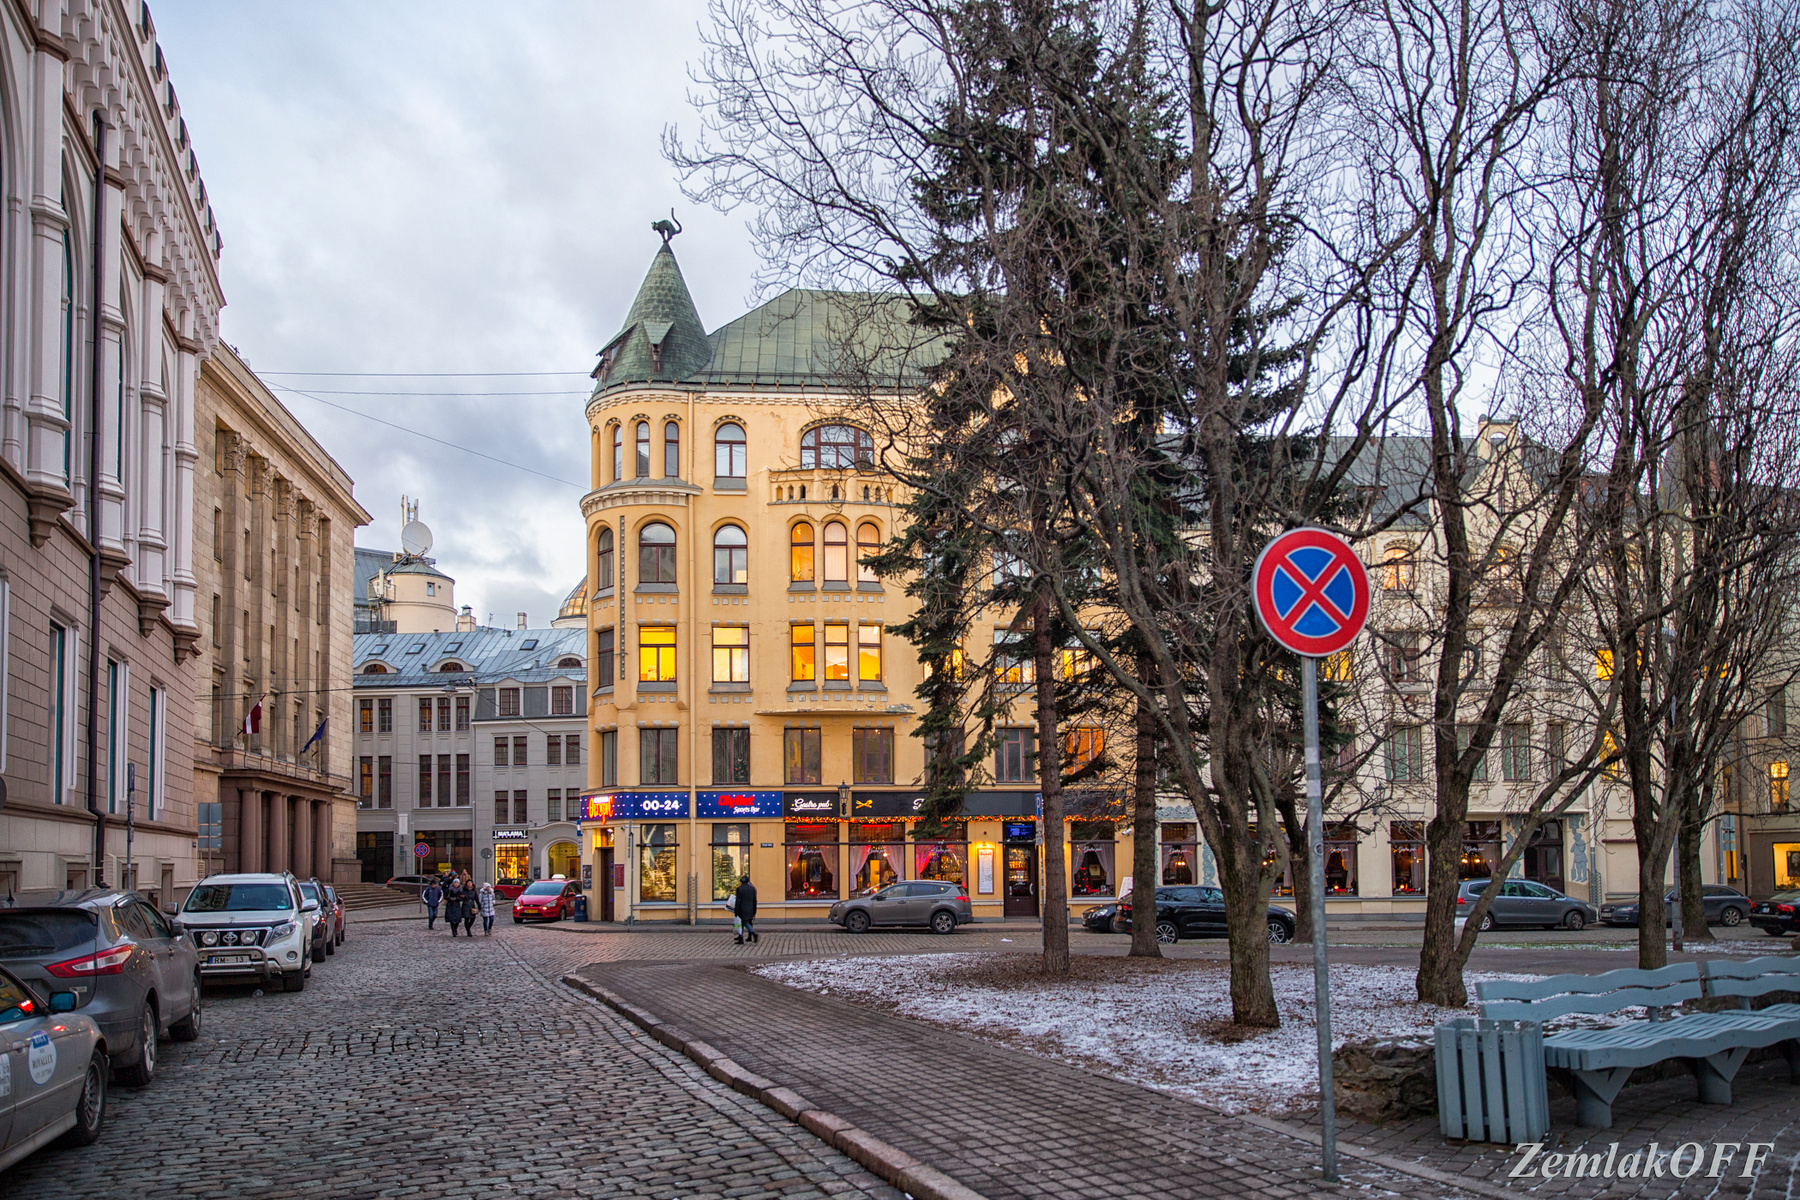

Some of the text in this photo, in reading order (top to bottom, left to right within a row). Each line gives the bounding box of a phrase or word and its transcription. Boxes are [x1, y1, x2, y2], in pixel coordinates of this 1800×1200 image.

[642, 799, 680, 811] 00-24
[718, 794, 755, 809] OlyBet
[794, 798, 831, 812] Gastro pub
[733, 806, 750, 814] Sports
